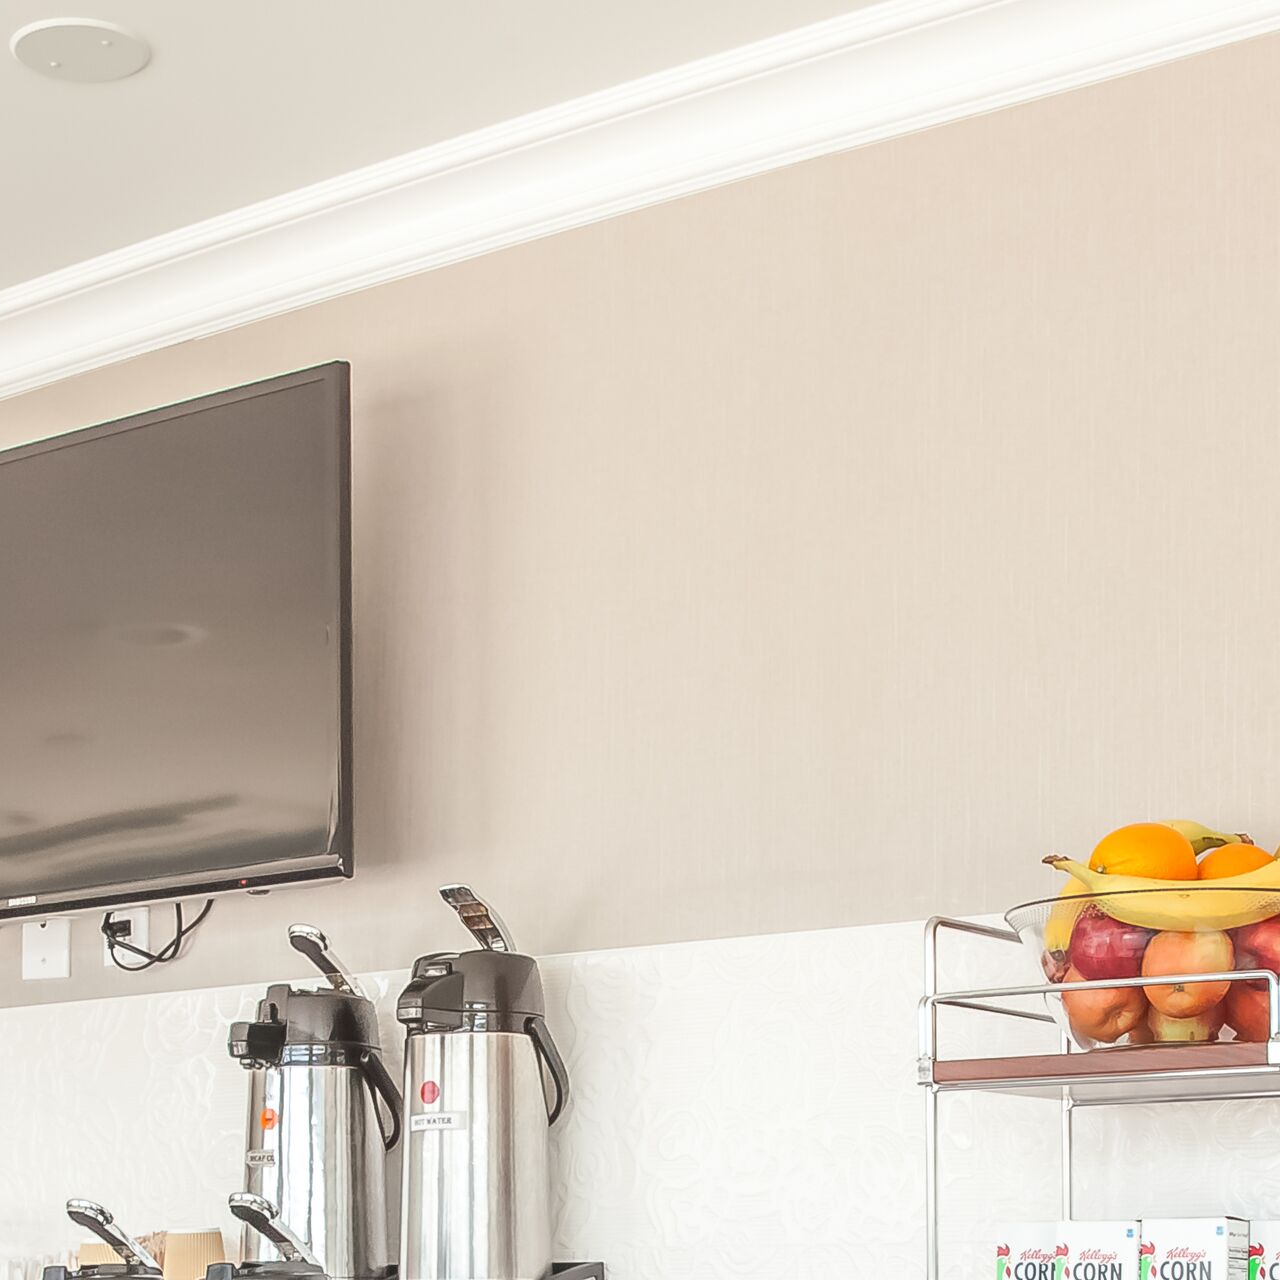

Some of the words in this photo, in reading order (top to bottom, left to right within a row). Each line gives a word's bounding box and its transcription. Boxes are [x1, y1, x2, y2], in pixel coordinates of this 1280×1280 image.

[1080, 1248, 1117, 1264] Kellogg's
[1166, 1247, 1206, 1262] Kellogg's
[1160, 1261, 1212, 1280] CORN
